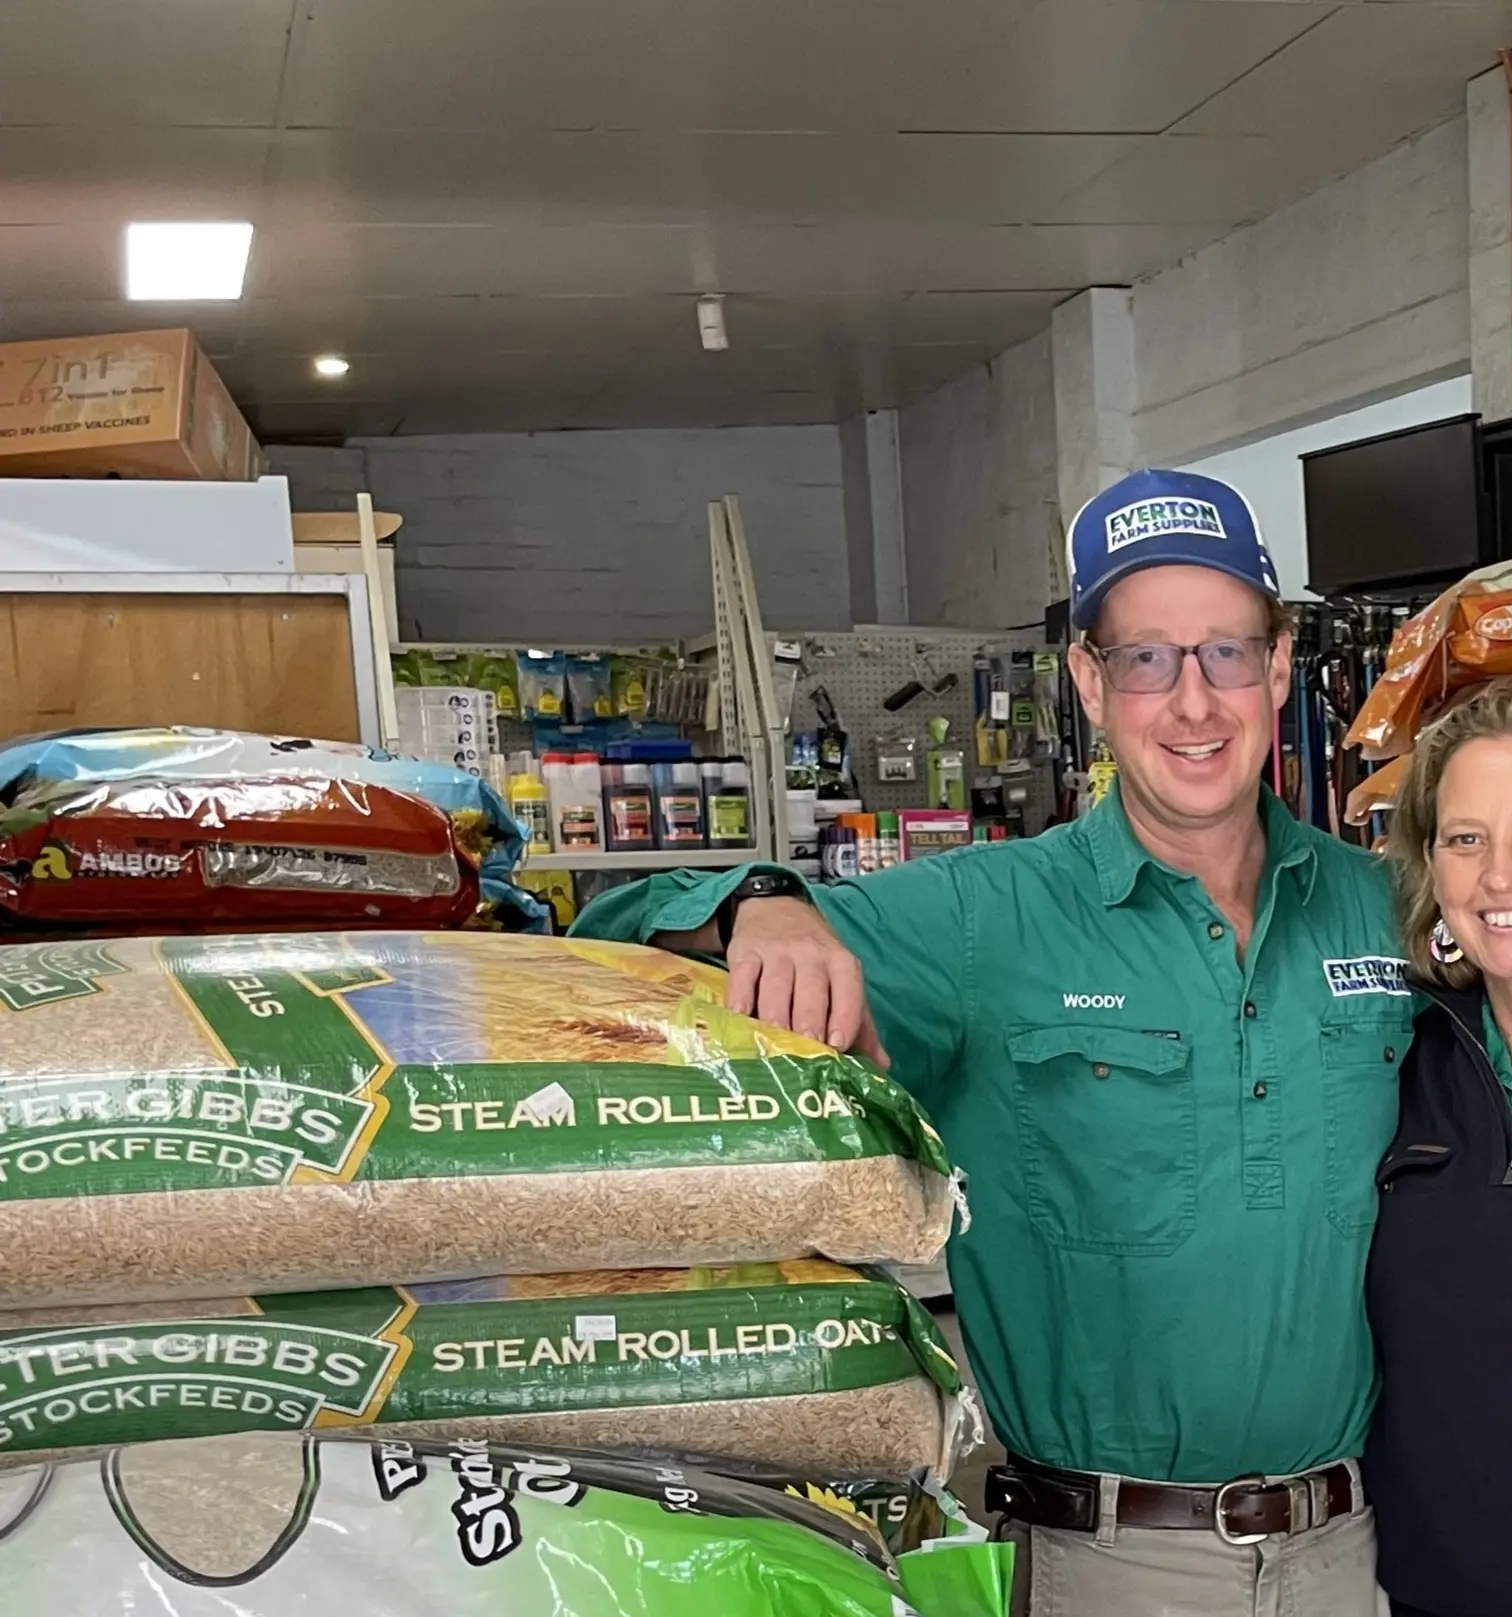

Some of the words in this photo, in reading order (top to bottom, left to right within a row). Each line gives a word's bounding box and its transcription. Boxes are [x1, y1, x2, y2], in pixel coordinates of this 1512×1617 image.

[39, 423, 81, 435] SHEEP
[85, 415, 152, 430] VACCINES
[1110, 501, 1217, 535] EVERTON
[1111, 525, 1149, 547] FARM
[1153, 519, 1221, 533] SUPPLIES
[1063, 993, 1125, 1010] WOODY
[125, 1088, 344, 1144] GIBBS
[409, 1099, 577, 1133] STEAM
[598, 1093, 780, 1126] ROLLED
[152, 1332, 368, 1387] GIBBS
[433, 1334, 597, 1373] STEAM
[617, 1322, 797, 1360] ROLLED
